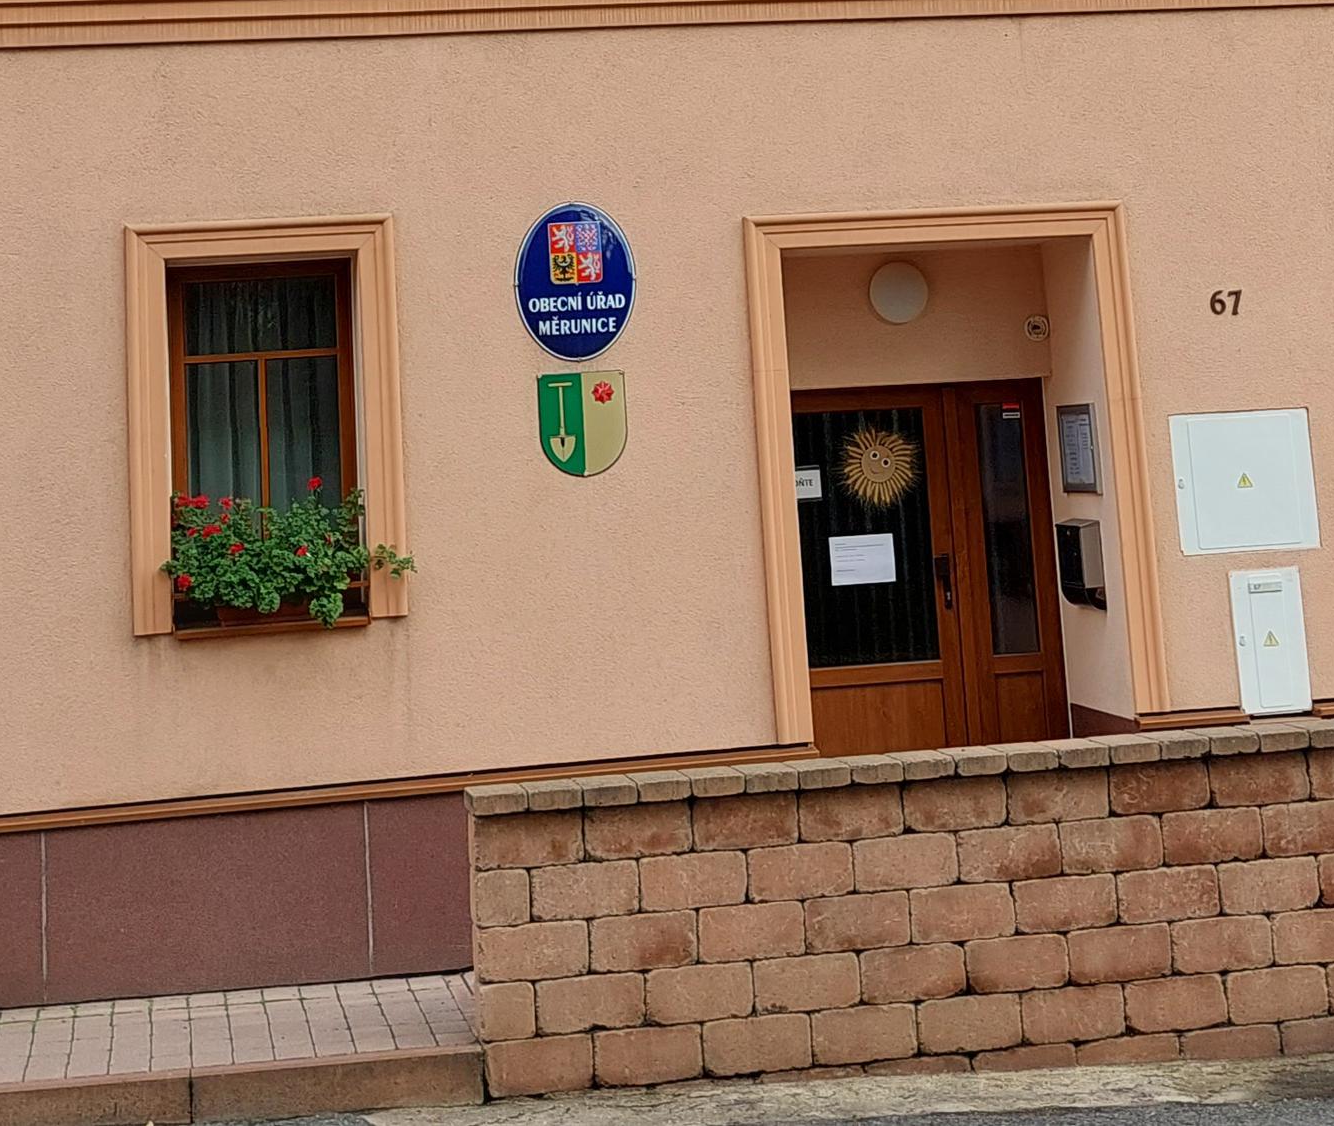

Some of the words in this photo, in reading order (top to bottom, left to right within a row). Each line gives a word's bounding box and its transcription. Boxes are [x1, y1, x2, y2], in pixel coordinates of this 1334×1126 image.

[528, 292, 582, 313] OBECNÍ
[586, 291, 626, 310] ÚŘAD
[1210, 289, 1242, 316] 67
[538, 316, 617, 336] MĚRUNICE
